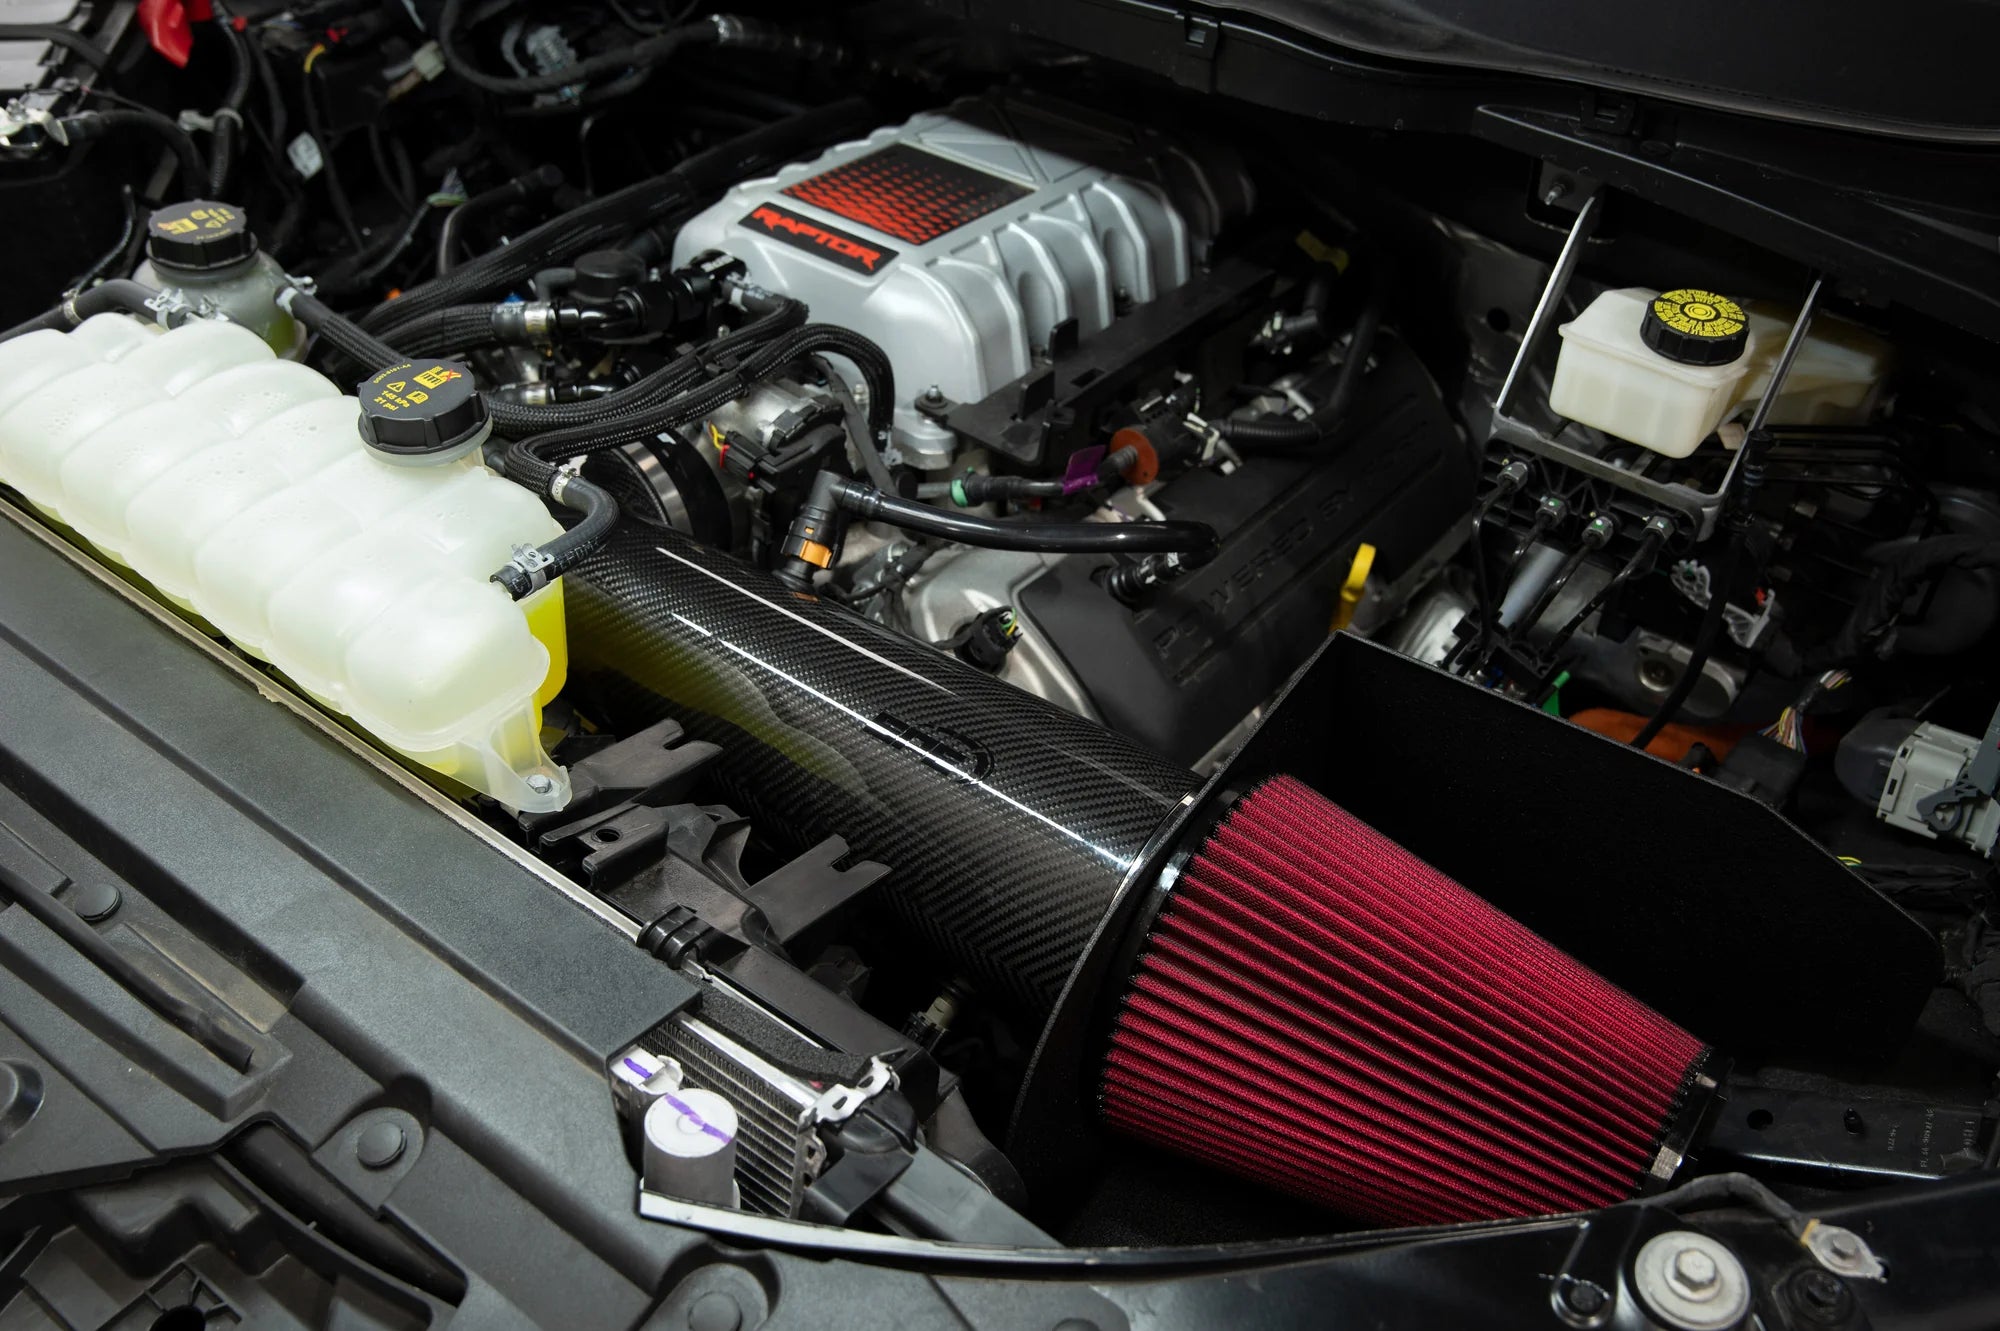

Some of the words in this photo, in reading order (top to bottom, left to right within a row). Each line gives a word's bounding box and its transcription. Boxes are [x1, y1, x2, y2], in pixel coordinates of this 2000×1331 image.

[752, 207, 881, 271] RAPTOR
[381, 390, 398, 400] 145
[395, 397, 410, 408] kPa
[1153, 518, 1314, 659] POWERED
